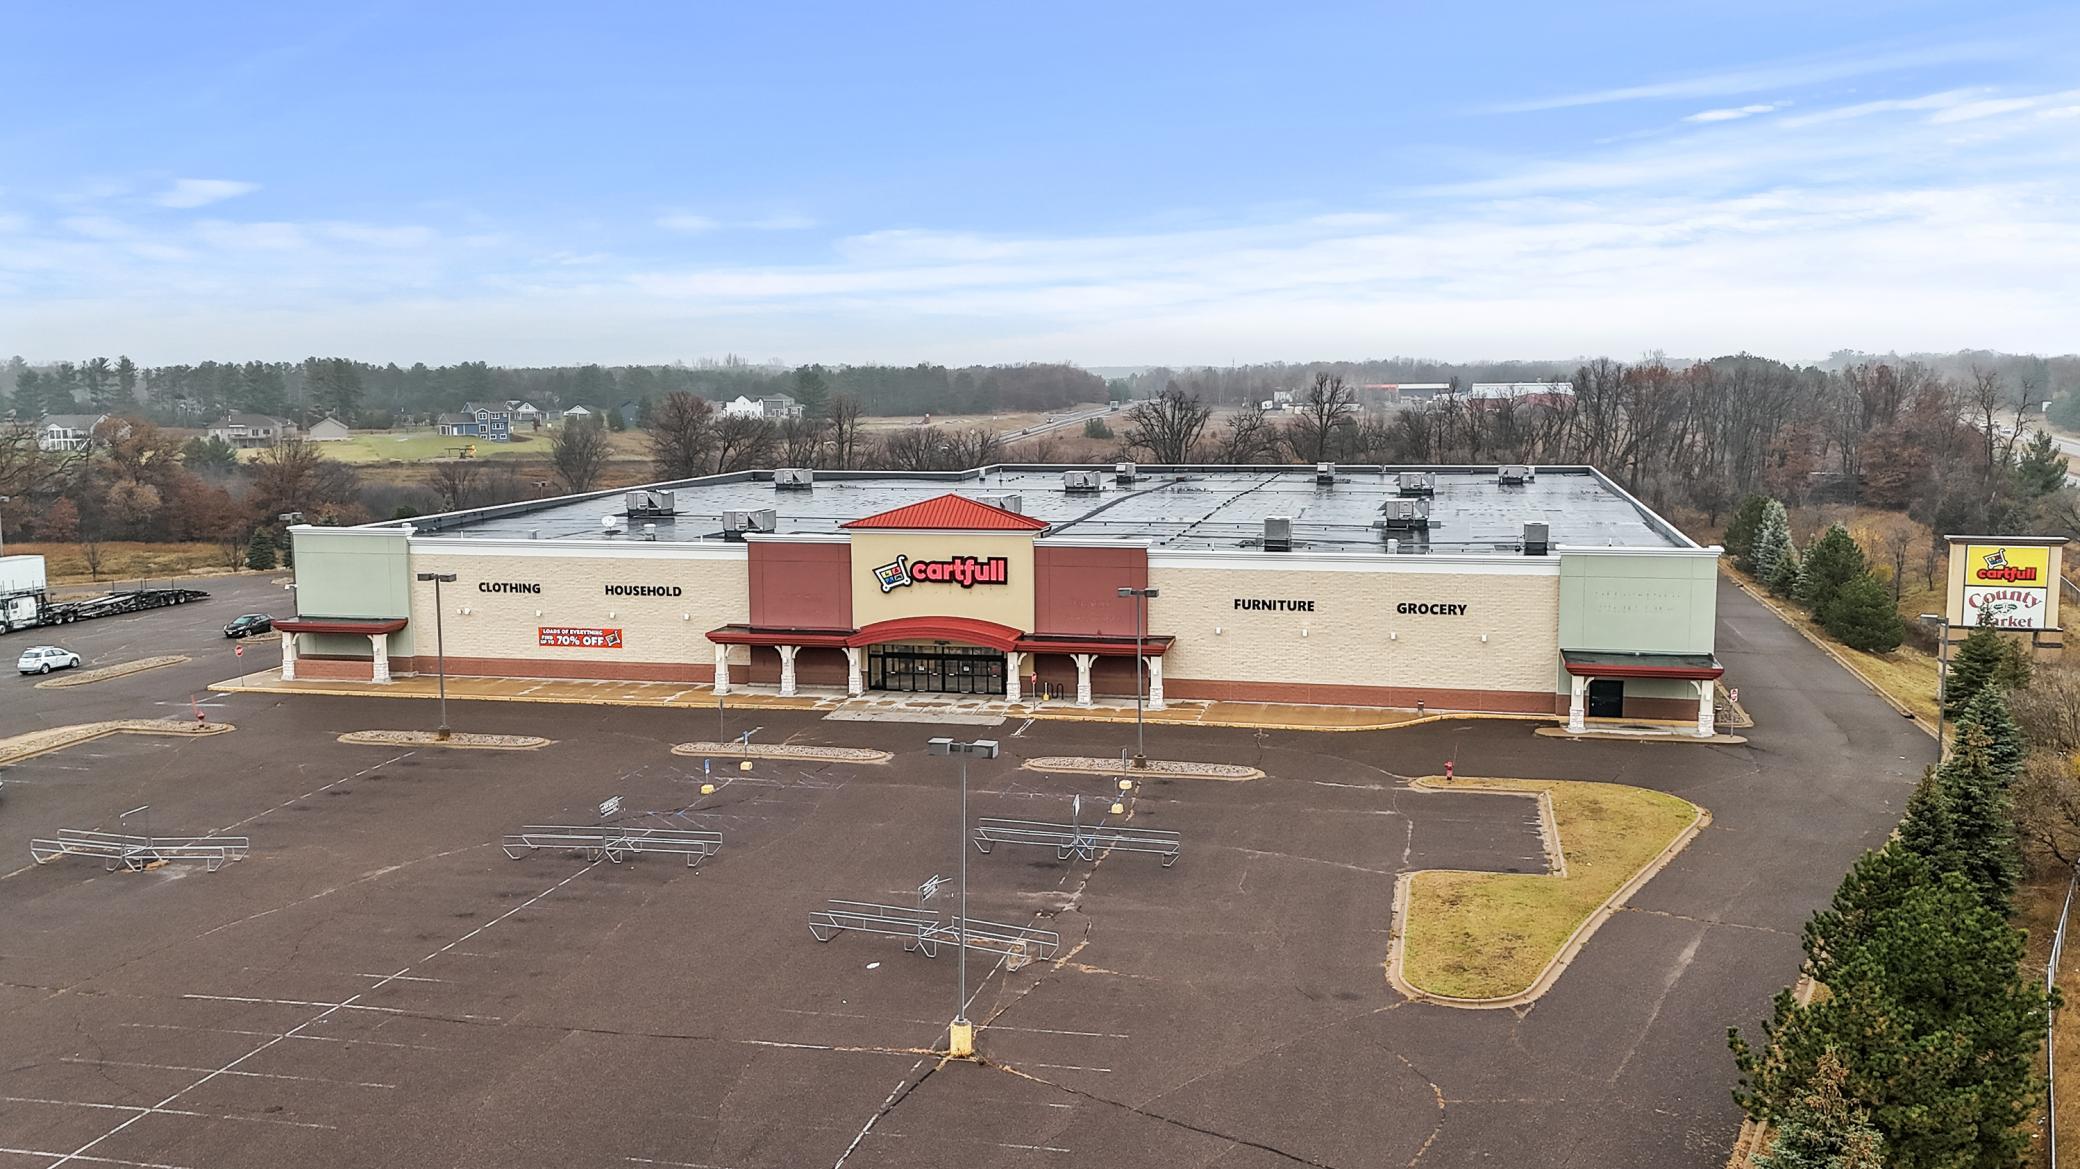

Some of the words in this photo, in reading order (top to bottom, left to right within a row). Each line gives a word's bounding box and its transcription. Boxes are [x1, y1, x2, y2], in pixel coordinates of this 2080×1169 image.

[911, 557, 1007, 587] cartfull
[1977, 567, 2037, 582] cartfull
[479, 582, 541, 594] CLOTHING
[605, 585, 682, 597] HOUSEHOLD
[1233, 598, 1315, 612] FURNITURE
[1968, 590, 2043, 609] County
[1396, 602, 1468, 616] GROCERY
[557, 635, 580, 645] 70%
[583, 636, 604, 646] OFF
